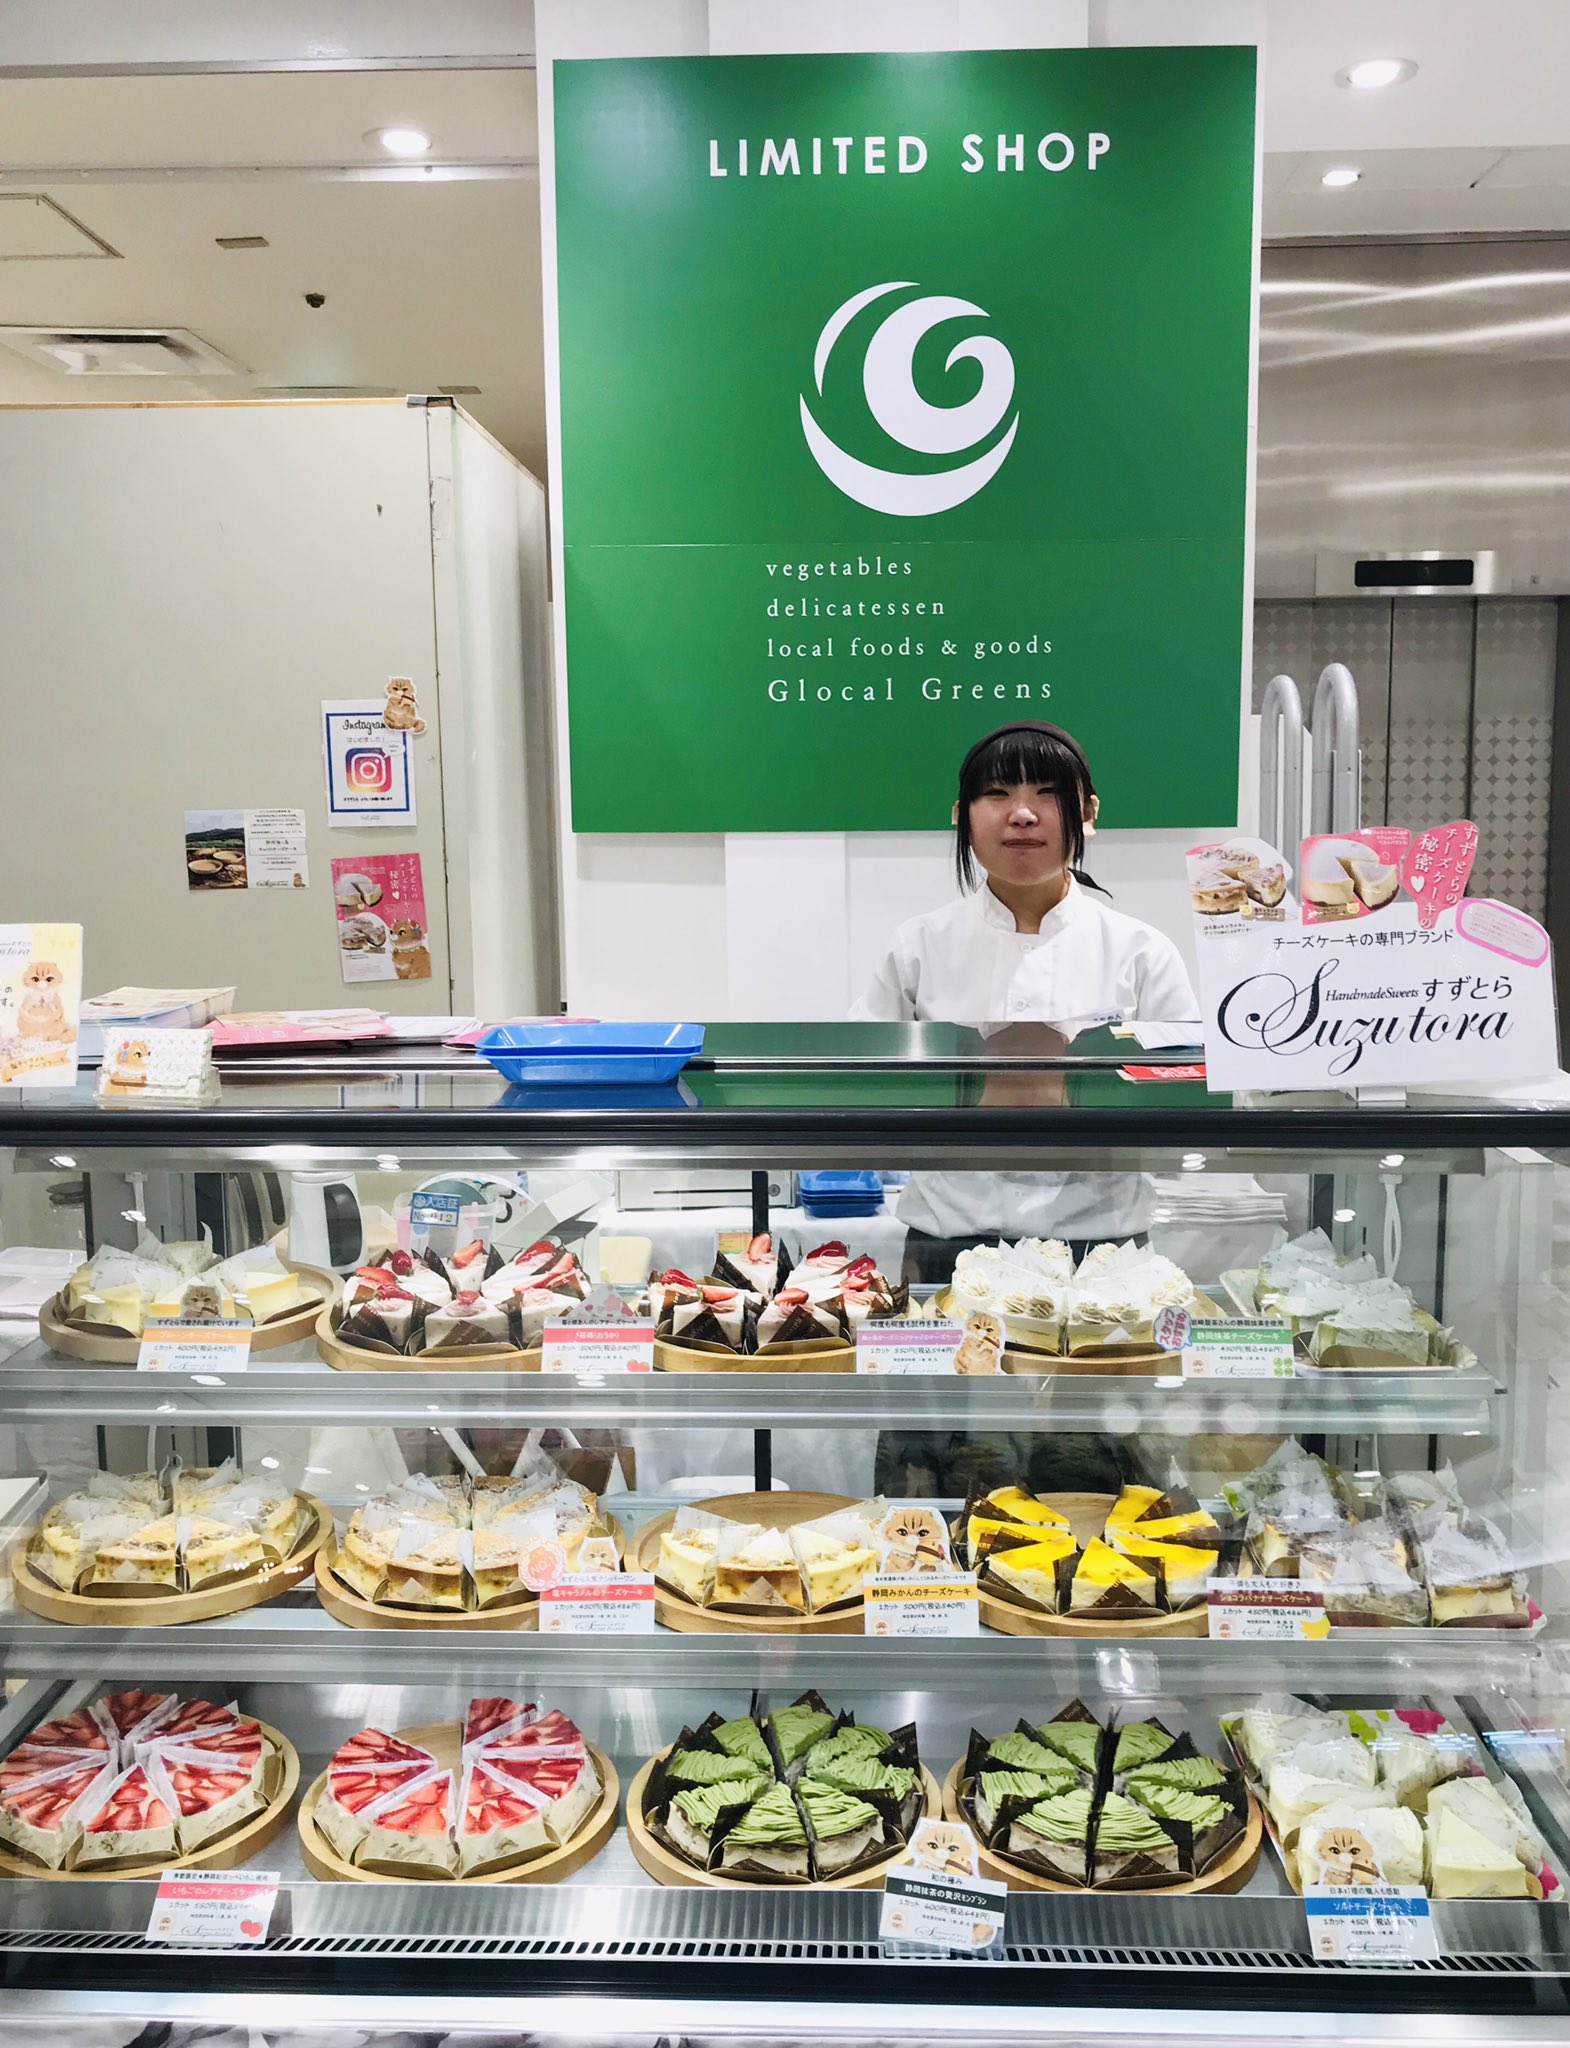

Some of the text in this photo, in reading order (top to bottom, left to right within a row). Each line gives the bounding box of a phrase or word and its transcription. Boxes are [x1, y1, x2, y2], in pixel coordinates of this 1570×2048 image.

[708, 132, 1111, 178] LIMITED SHOP
[765, 557, 912, 581] vegetables
[766, 597, 944, 617] delicatessen
[767, 635, 1052, 660] local foods & goods
[768, 677, 1051, 702] Glocal Greens
[1445, 825, 1478, 904] すずとらの
[1420, 828, 1457, 930] チーズケーキの
[1272, 929, 1455, 951] チーズケーキの専門ブランド
[1421, 975, 1513, 1002] すずとら
[869, 1320, 955, 1329] 何度も何度も試作を重ねた
[1196, 1331, 1281, 1341] 静岡抹茶チーズケーキ
[551, 1588, 644, 1598] 塩キャラメルのチーズケーキ
[872, 1587, 971, 1598] 静岡みかんのチーズケーキ
[1219, 1594, 1312, 1604] ショコラバナナチーズケーキ
[904, 1883, 988, 1906] 静岡抹茶の贅沢モンブラン
